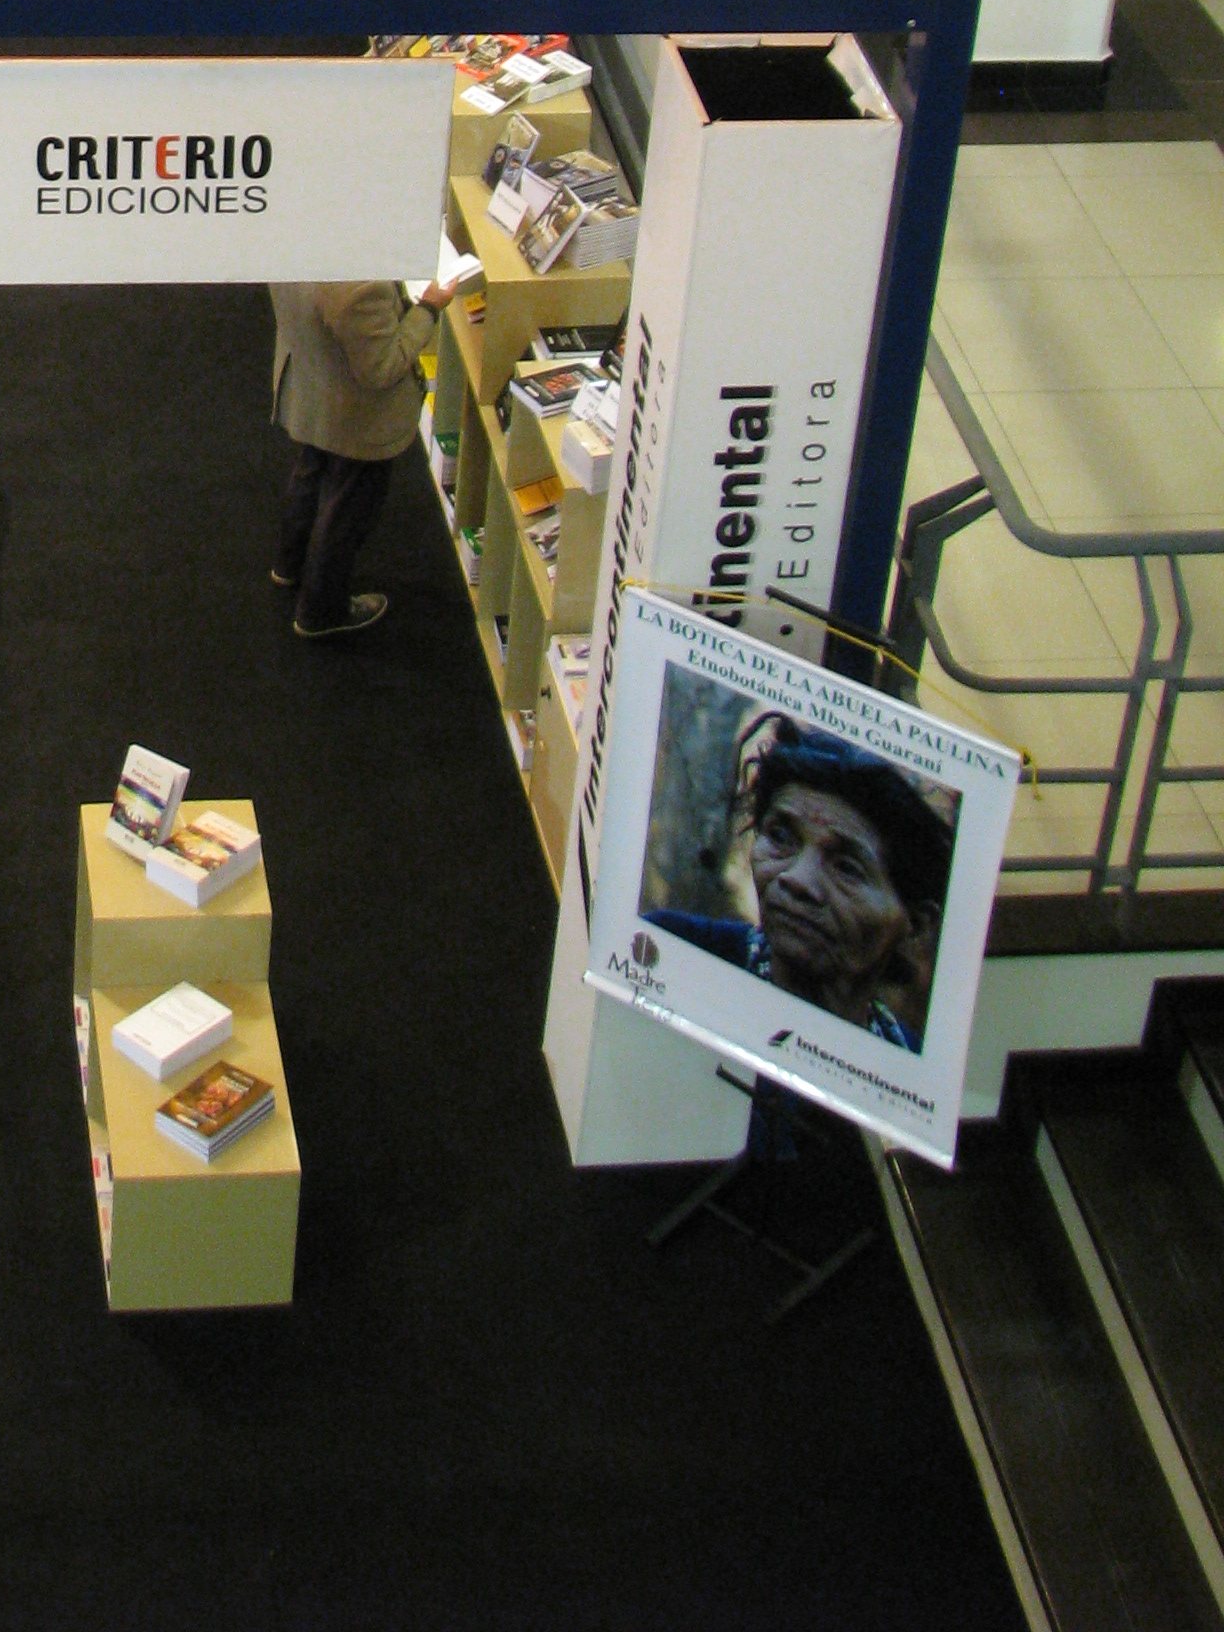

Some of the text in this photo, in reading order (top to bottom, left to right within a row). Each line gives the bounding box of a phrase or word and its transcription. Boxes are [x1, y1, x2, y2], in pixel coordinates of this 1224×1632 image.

[36, 134, 273, 181] CRITERIO
[36, 185, 268, 215] EDICIONES
[776, 378, 837, 580] Editora
[635, 603, 1006, 779] LA BOTICA DE LA ABUELA PAULINA
[687, 648, 944, 776] Etnobotánica Mbya Guaraní
[607, 952, 667, 995] Madre
[797, 1035, 935, 1113] Intercontinental
